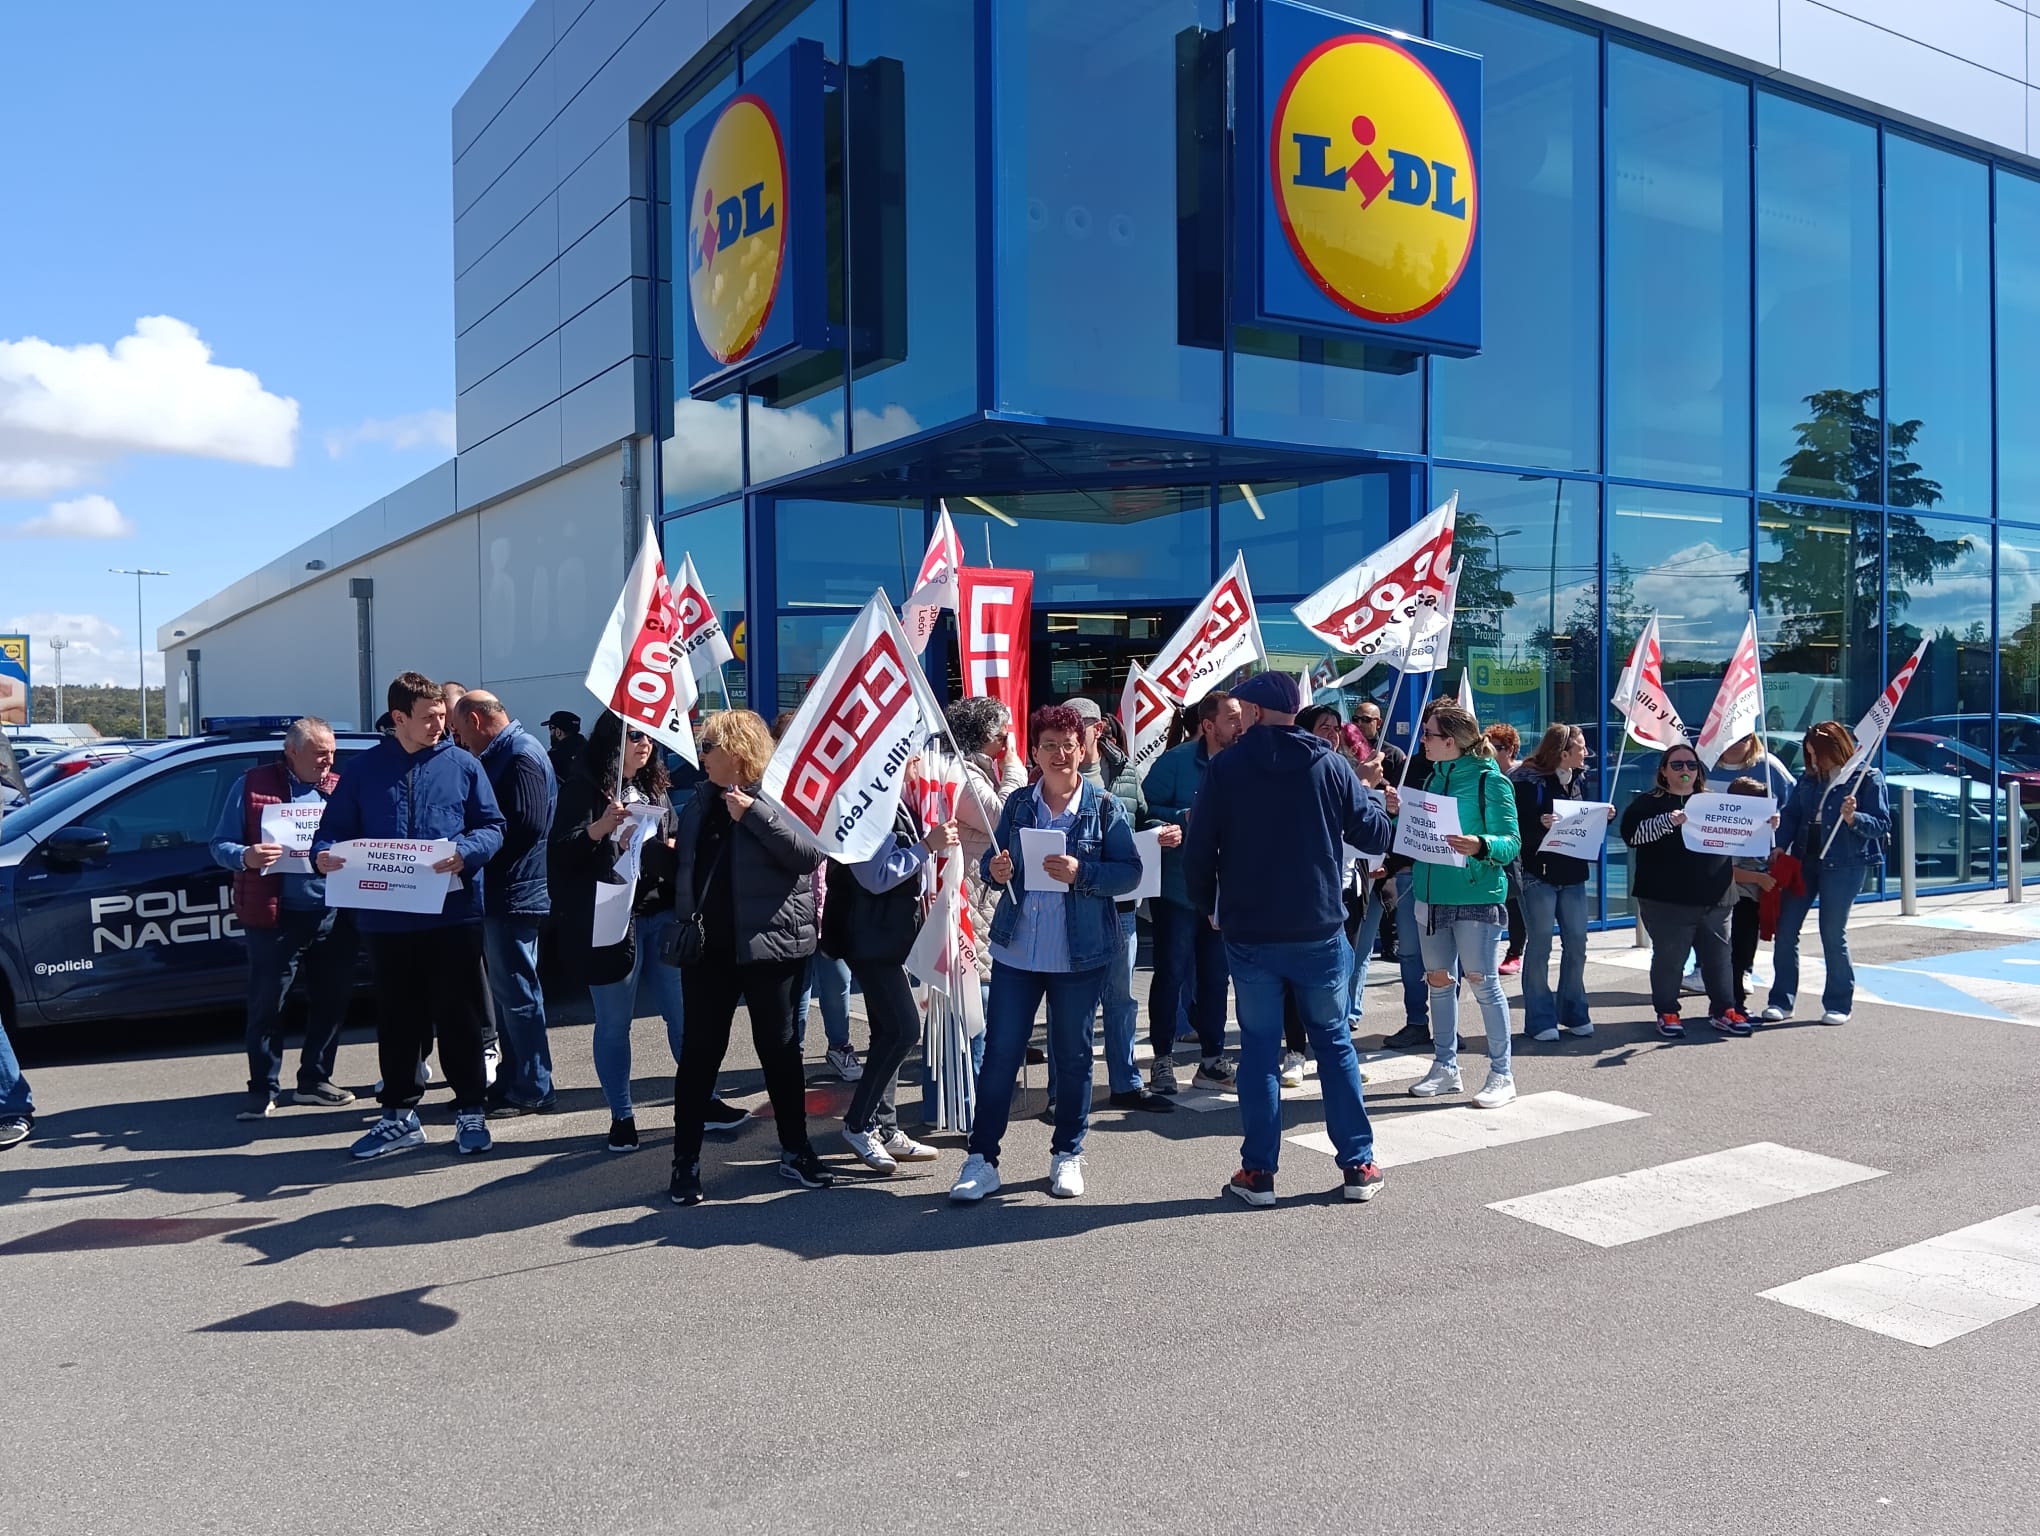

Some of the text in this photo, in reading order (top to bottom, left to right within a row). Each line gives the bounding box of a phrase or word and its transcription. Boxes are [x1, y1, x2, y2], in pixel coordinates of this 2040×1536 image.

[1657, 710, 1669, 721] y
[280, 808, 294, 818] EN
[1719, 803, 1742, 812] STOP
[369, 841, 417, 852] DEFENSA
[419, 844, 434, 853] DE
[367, 851, 417, 863] NUESTRO
[366, 862, 415, 875] TRABAJO
[360, 881, 388, 890] CCOO
[34, 958, 94, 976] @policia
